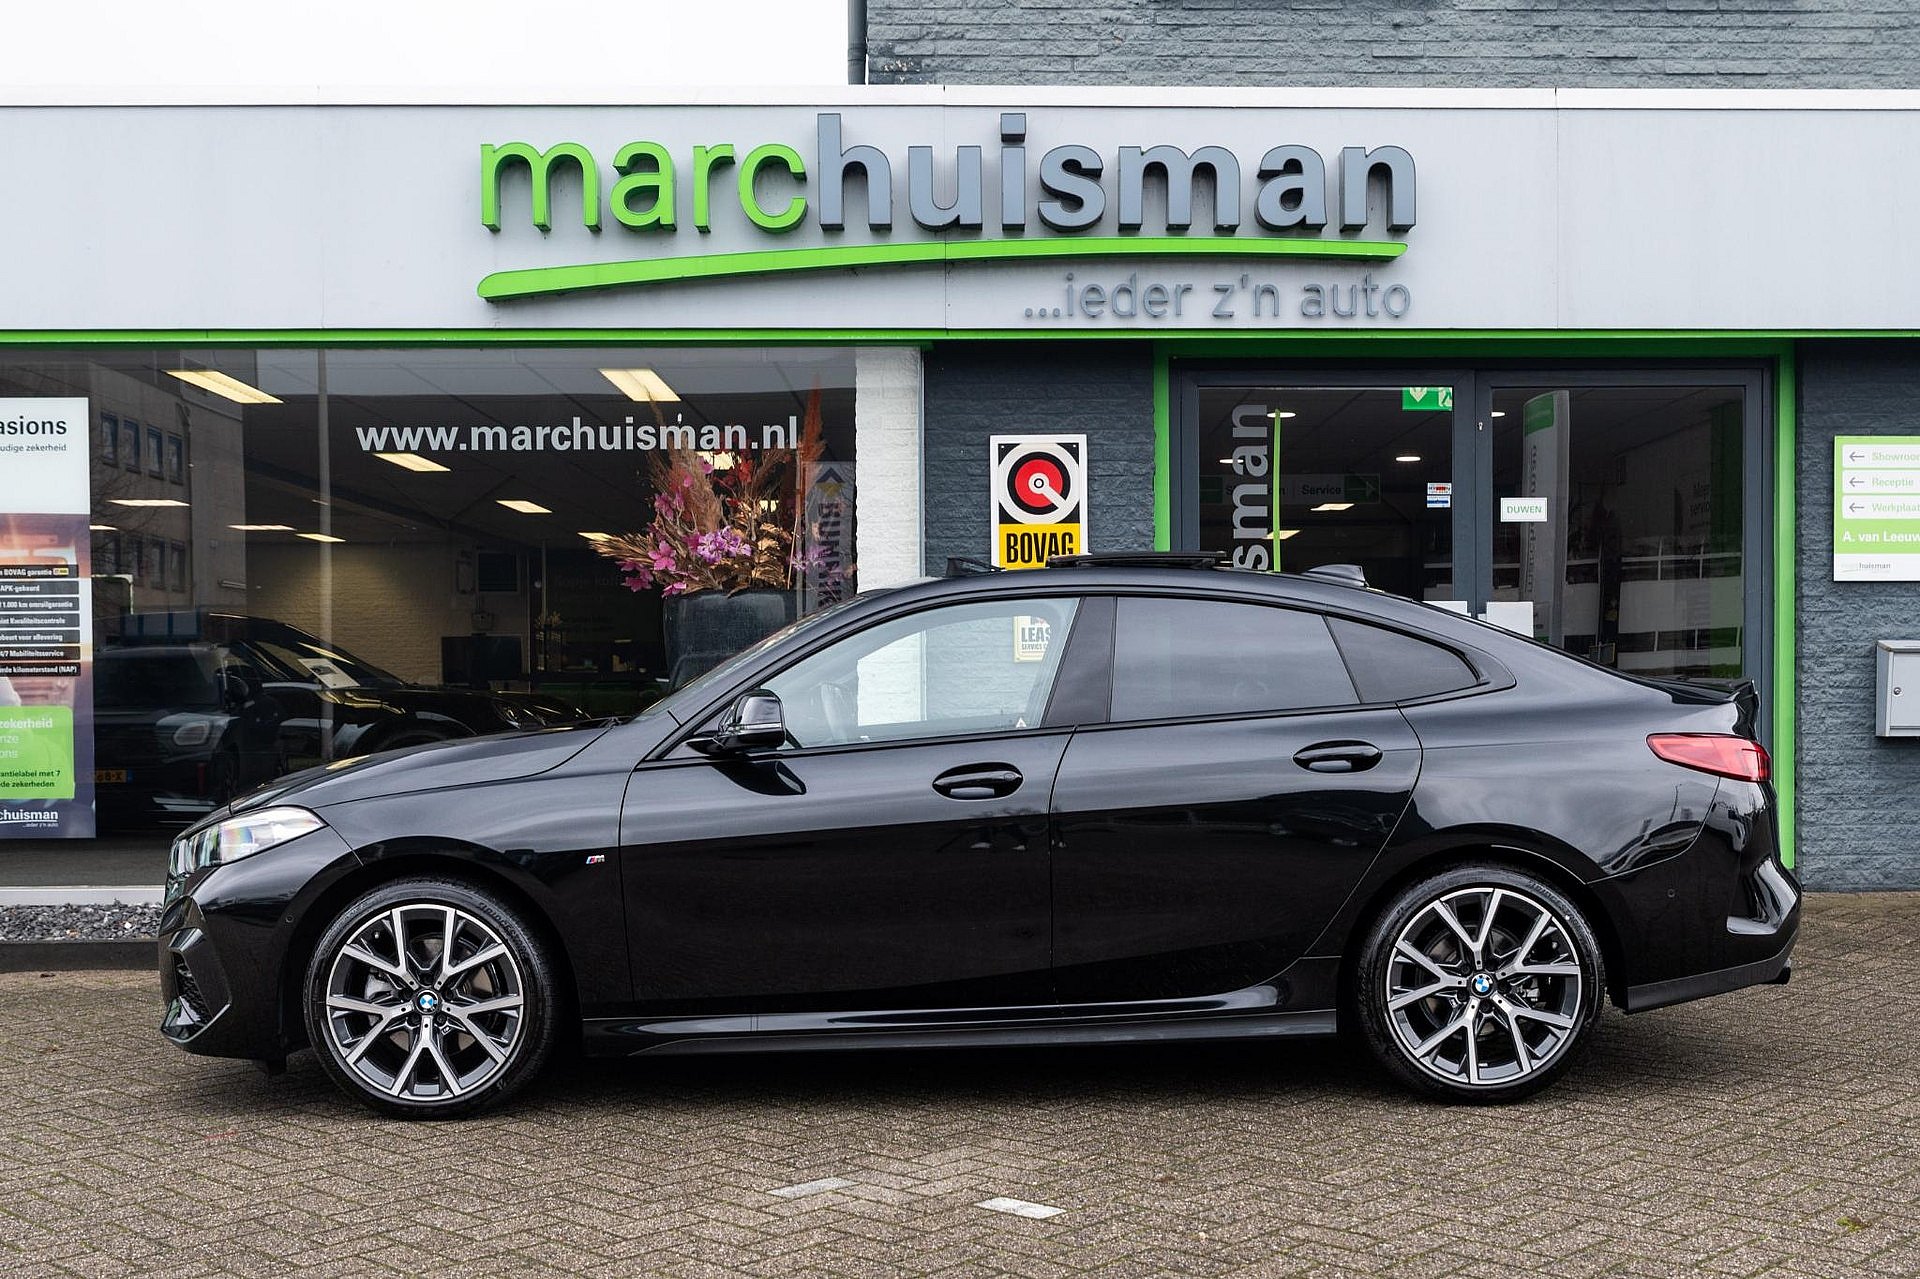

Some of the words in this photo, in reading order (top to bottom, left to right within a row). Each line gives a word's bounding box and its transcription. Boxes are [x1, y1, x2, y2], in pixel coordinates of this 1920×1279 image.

[481, 112, 1417, 233] marchuisman
[1213, 273, 1280, 319] z'n
[1301, 275, 1411, 319] auto
[356, 416, 797, 451] www.marchuisman.nl
[26, 444, 67, 452] zekerheid
[1872, 478, 1913, 488] Receptie
[1302, 485, 1341, 494] Service
[1507, 505, 1542, 514] DUWEN
[1859, 533, 1880, 542] van
[1006, 532, 1074, 563] BOVAG
[59, 666, 77, 674] (NAP)
